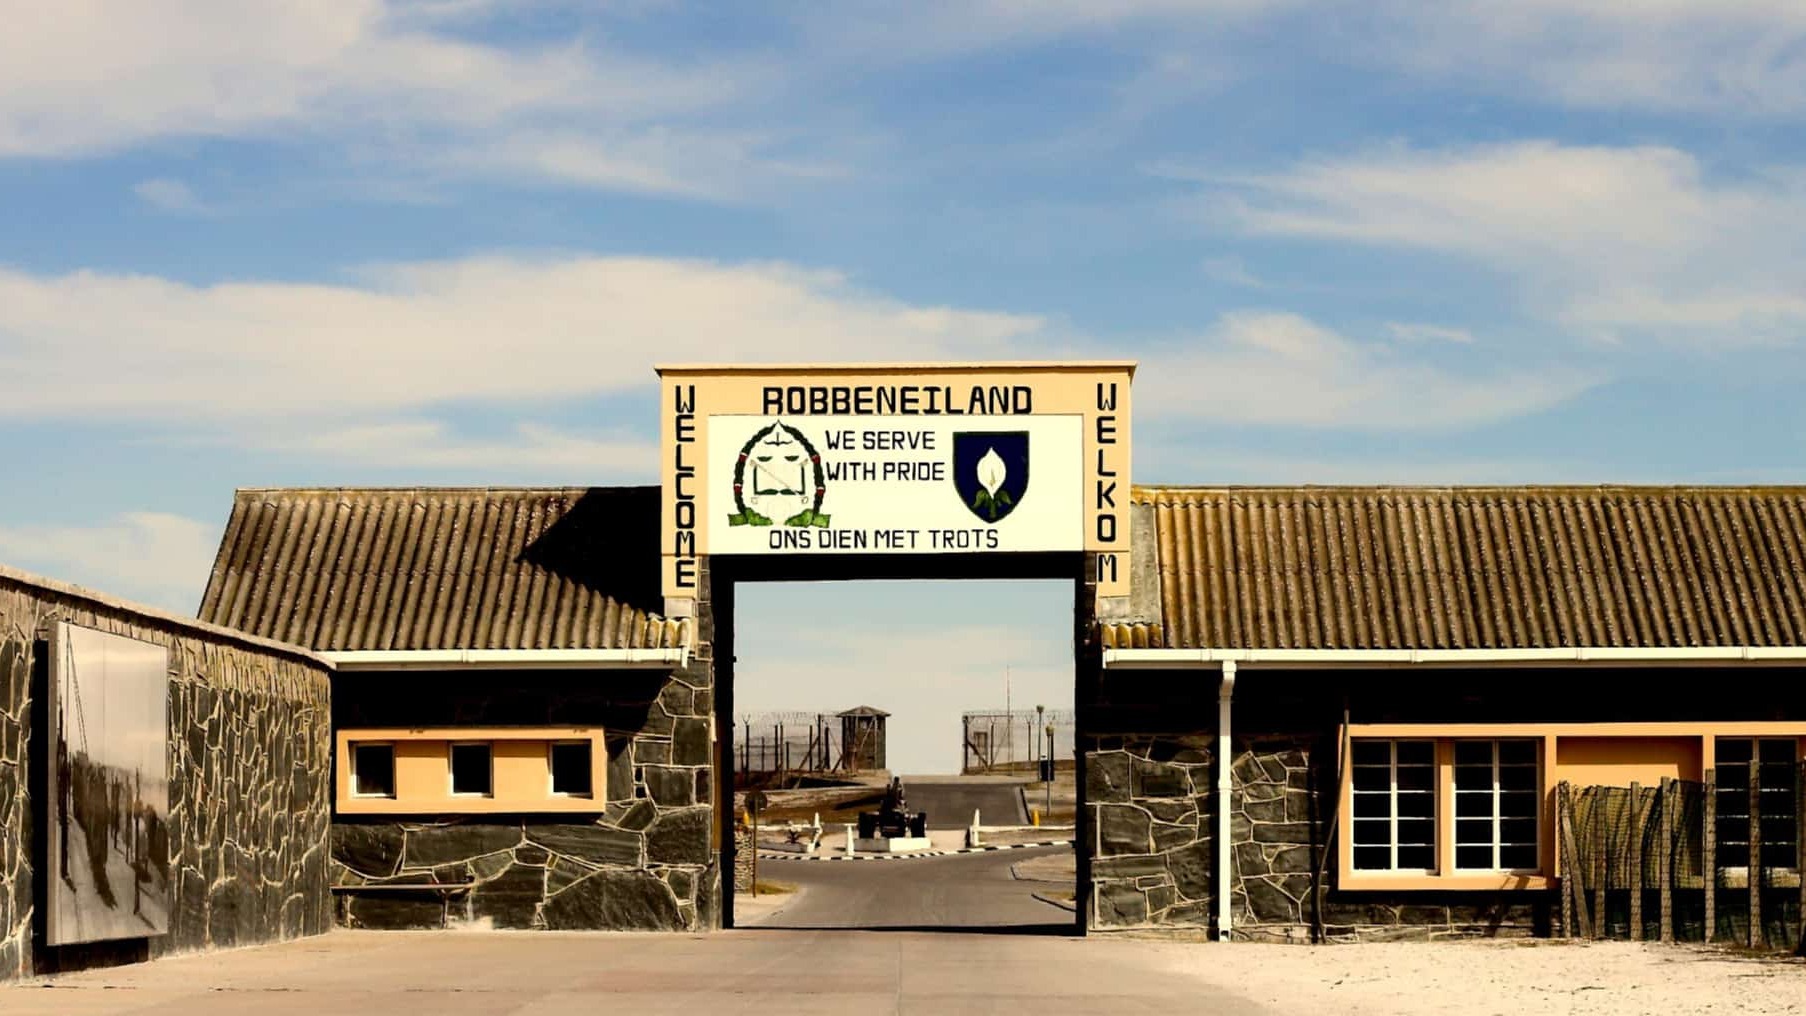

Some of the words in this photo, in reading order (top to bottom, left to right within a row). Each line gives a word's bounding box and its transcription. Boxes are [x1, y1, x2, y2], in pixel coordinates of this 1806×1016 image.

[763, 386, 1032, 415] ROBBENEILAND
[826, 431, 856, 450] WE
[863, 431, 936, 450] SERVE
[826, 462, 876, 481] WITH
[884, 462, 945, 481] PRIDE
[1097, 383, 1117, 582] WELKOM
[675, 385, 696, 588] WELCOME
[769, 529, 811, 549] ONS
[818, 529, 867, 549] DIEN
[874, 530, 920, 549] MET
[929, 529, 999, 549] TROTS
